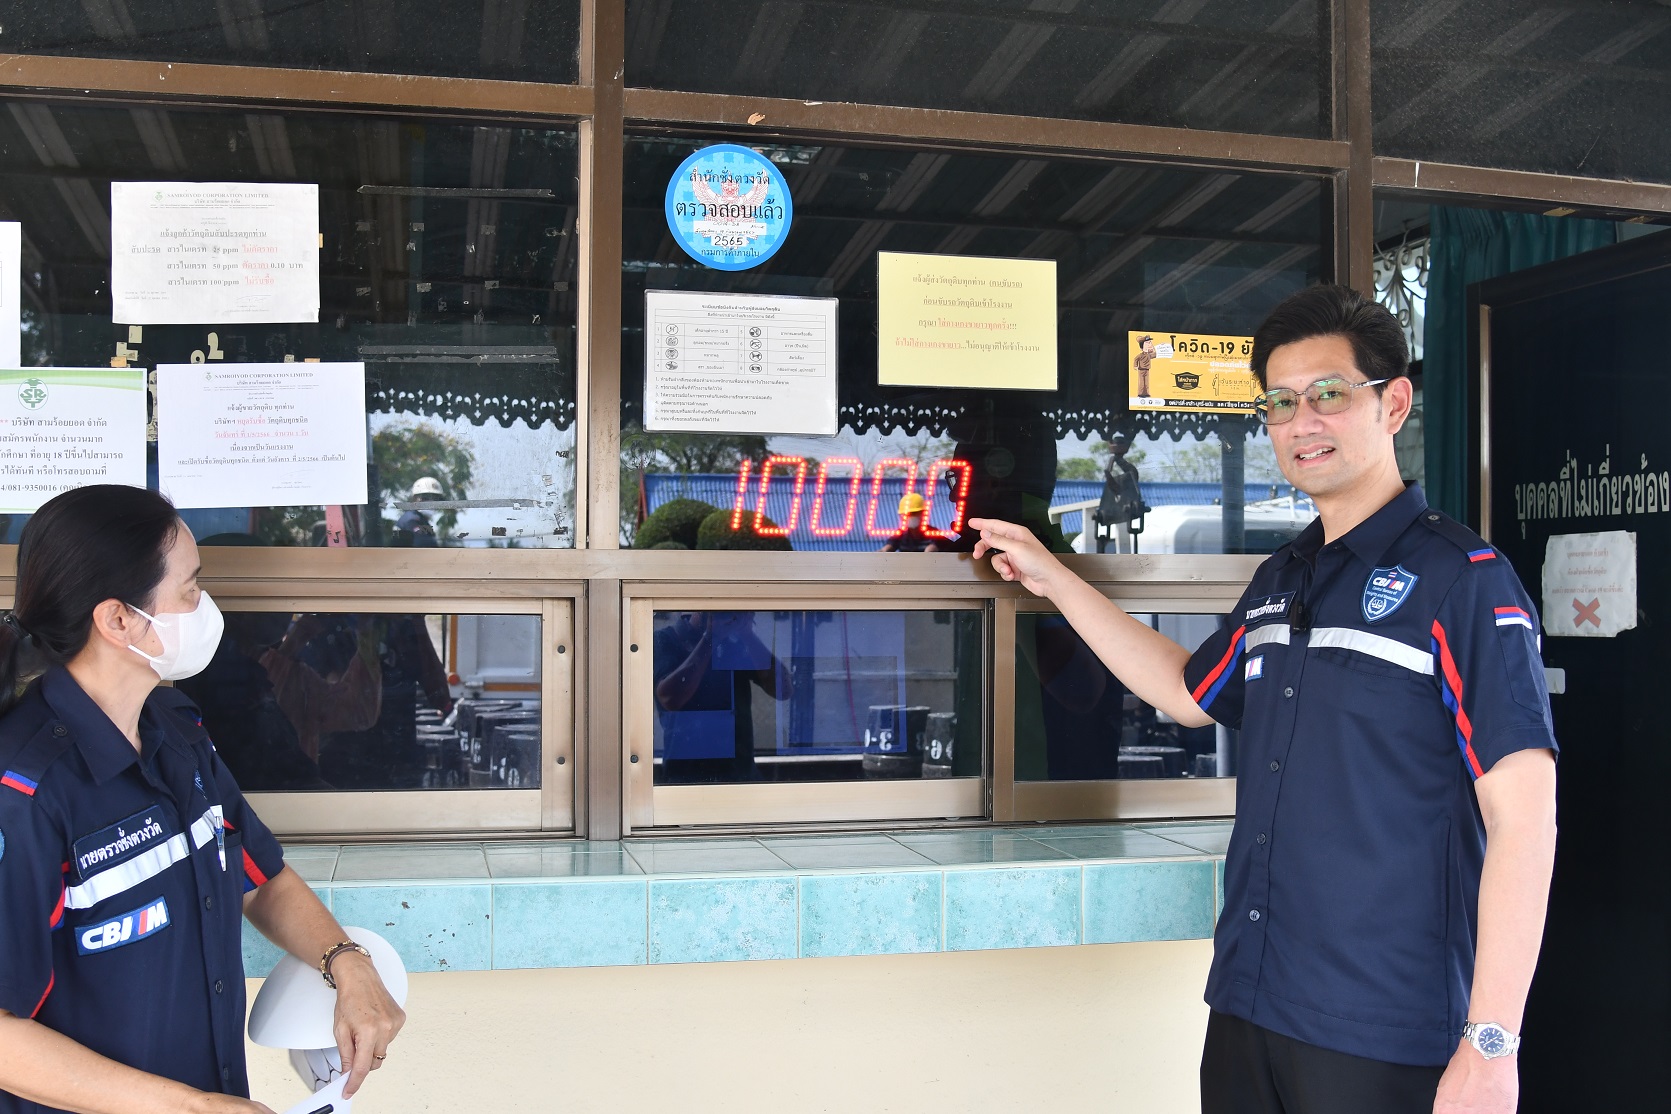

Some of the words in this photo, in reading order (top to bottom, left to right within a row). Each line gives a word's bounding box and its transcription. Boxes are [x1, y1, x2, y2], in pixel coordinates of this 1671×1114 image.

[676, 198, 783, 219] ตรวจสอบแล้ว
[714, 236, 743, 246] 2565
[701, 248, 760, 258] กรมการค้าภายใน
[222, 264, 239, 272] ppm
[223, 279, 240, 287] ppm
[1170, 335, 1235, 355] โควิด-19
[11, 416, 35, 427] บริษัท
[37, 417, 85, 427] สามร้อยยอด
[87, 417, 108, 427] จำกัด
[61, 434, 103, 443] จำนวนมาก
[30, 446, 51, 461] ที่อายุ
[53, 451, 62, 459] 18
[65, 446, 124, 459] ปีขึ้นไปสามารถ
[37, 463, 107, 476] หรือโทรสอบถามที่
[731, 455, 973, 537] 10000
[1514, 443, 1670, 540] บุคคลที่ไม่เกี่ยวข้อง
[80, 817, 163, 870] นายตรวจชั่งตวงวัด
